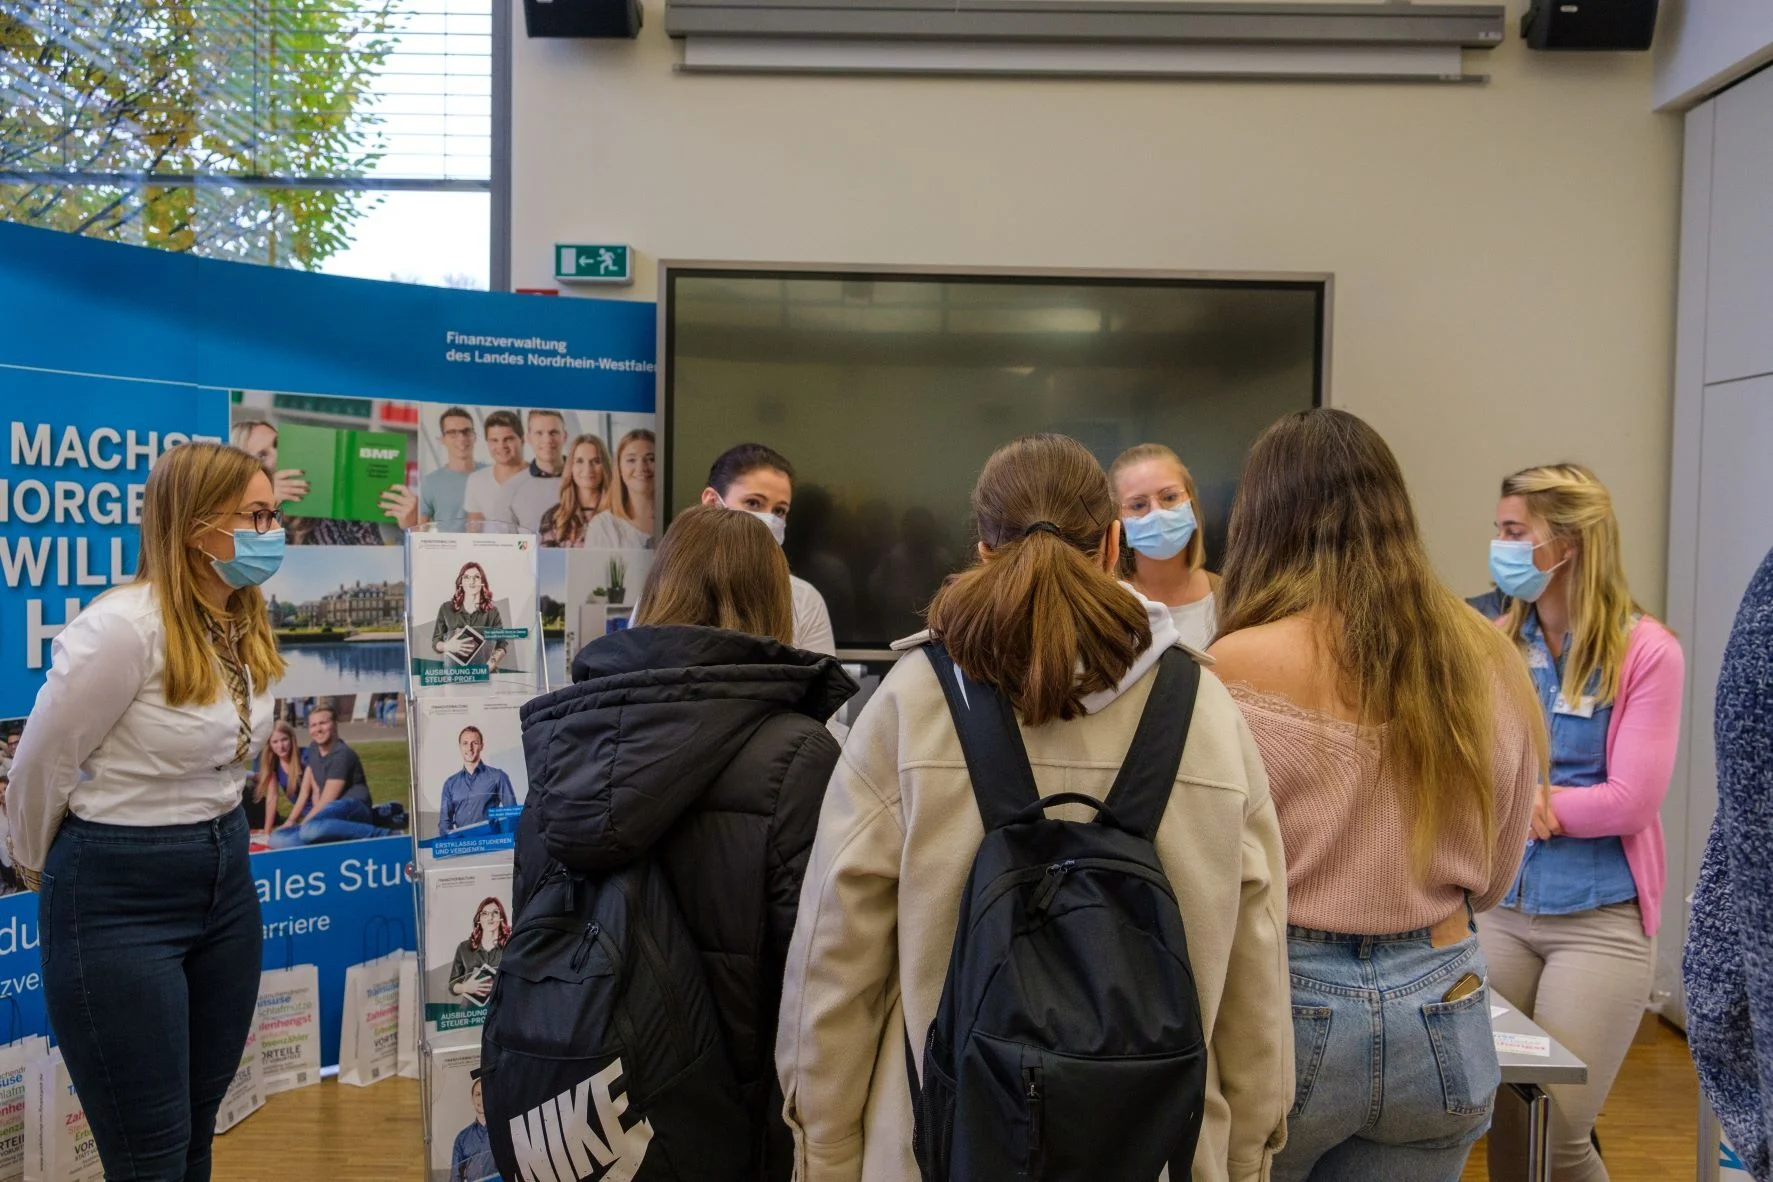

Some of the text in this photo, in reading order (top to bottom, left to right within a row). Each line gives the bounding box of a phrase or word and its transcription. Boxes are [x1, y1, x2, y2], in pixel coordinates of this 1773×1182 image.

[446, 331, 567, 352] Finanzverwaltung
[446, 349, 471, 362] des
[475, 350, 524, 366] Landes
[11, 421, 222, 470] MACH
[360, 448, 400, 460] BMF
[0, 478, 146, 525] ORGE
[425, 668, 470, 676] AUSBILDUNG
[425, 675, 476, 683] STEUER-PROFI
[440, 1009, 487, 1020] AUSBILDUNG
[509, 1057, 654, 1182] NIKE
